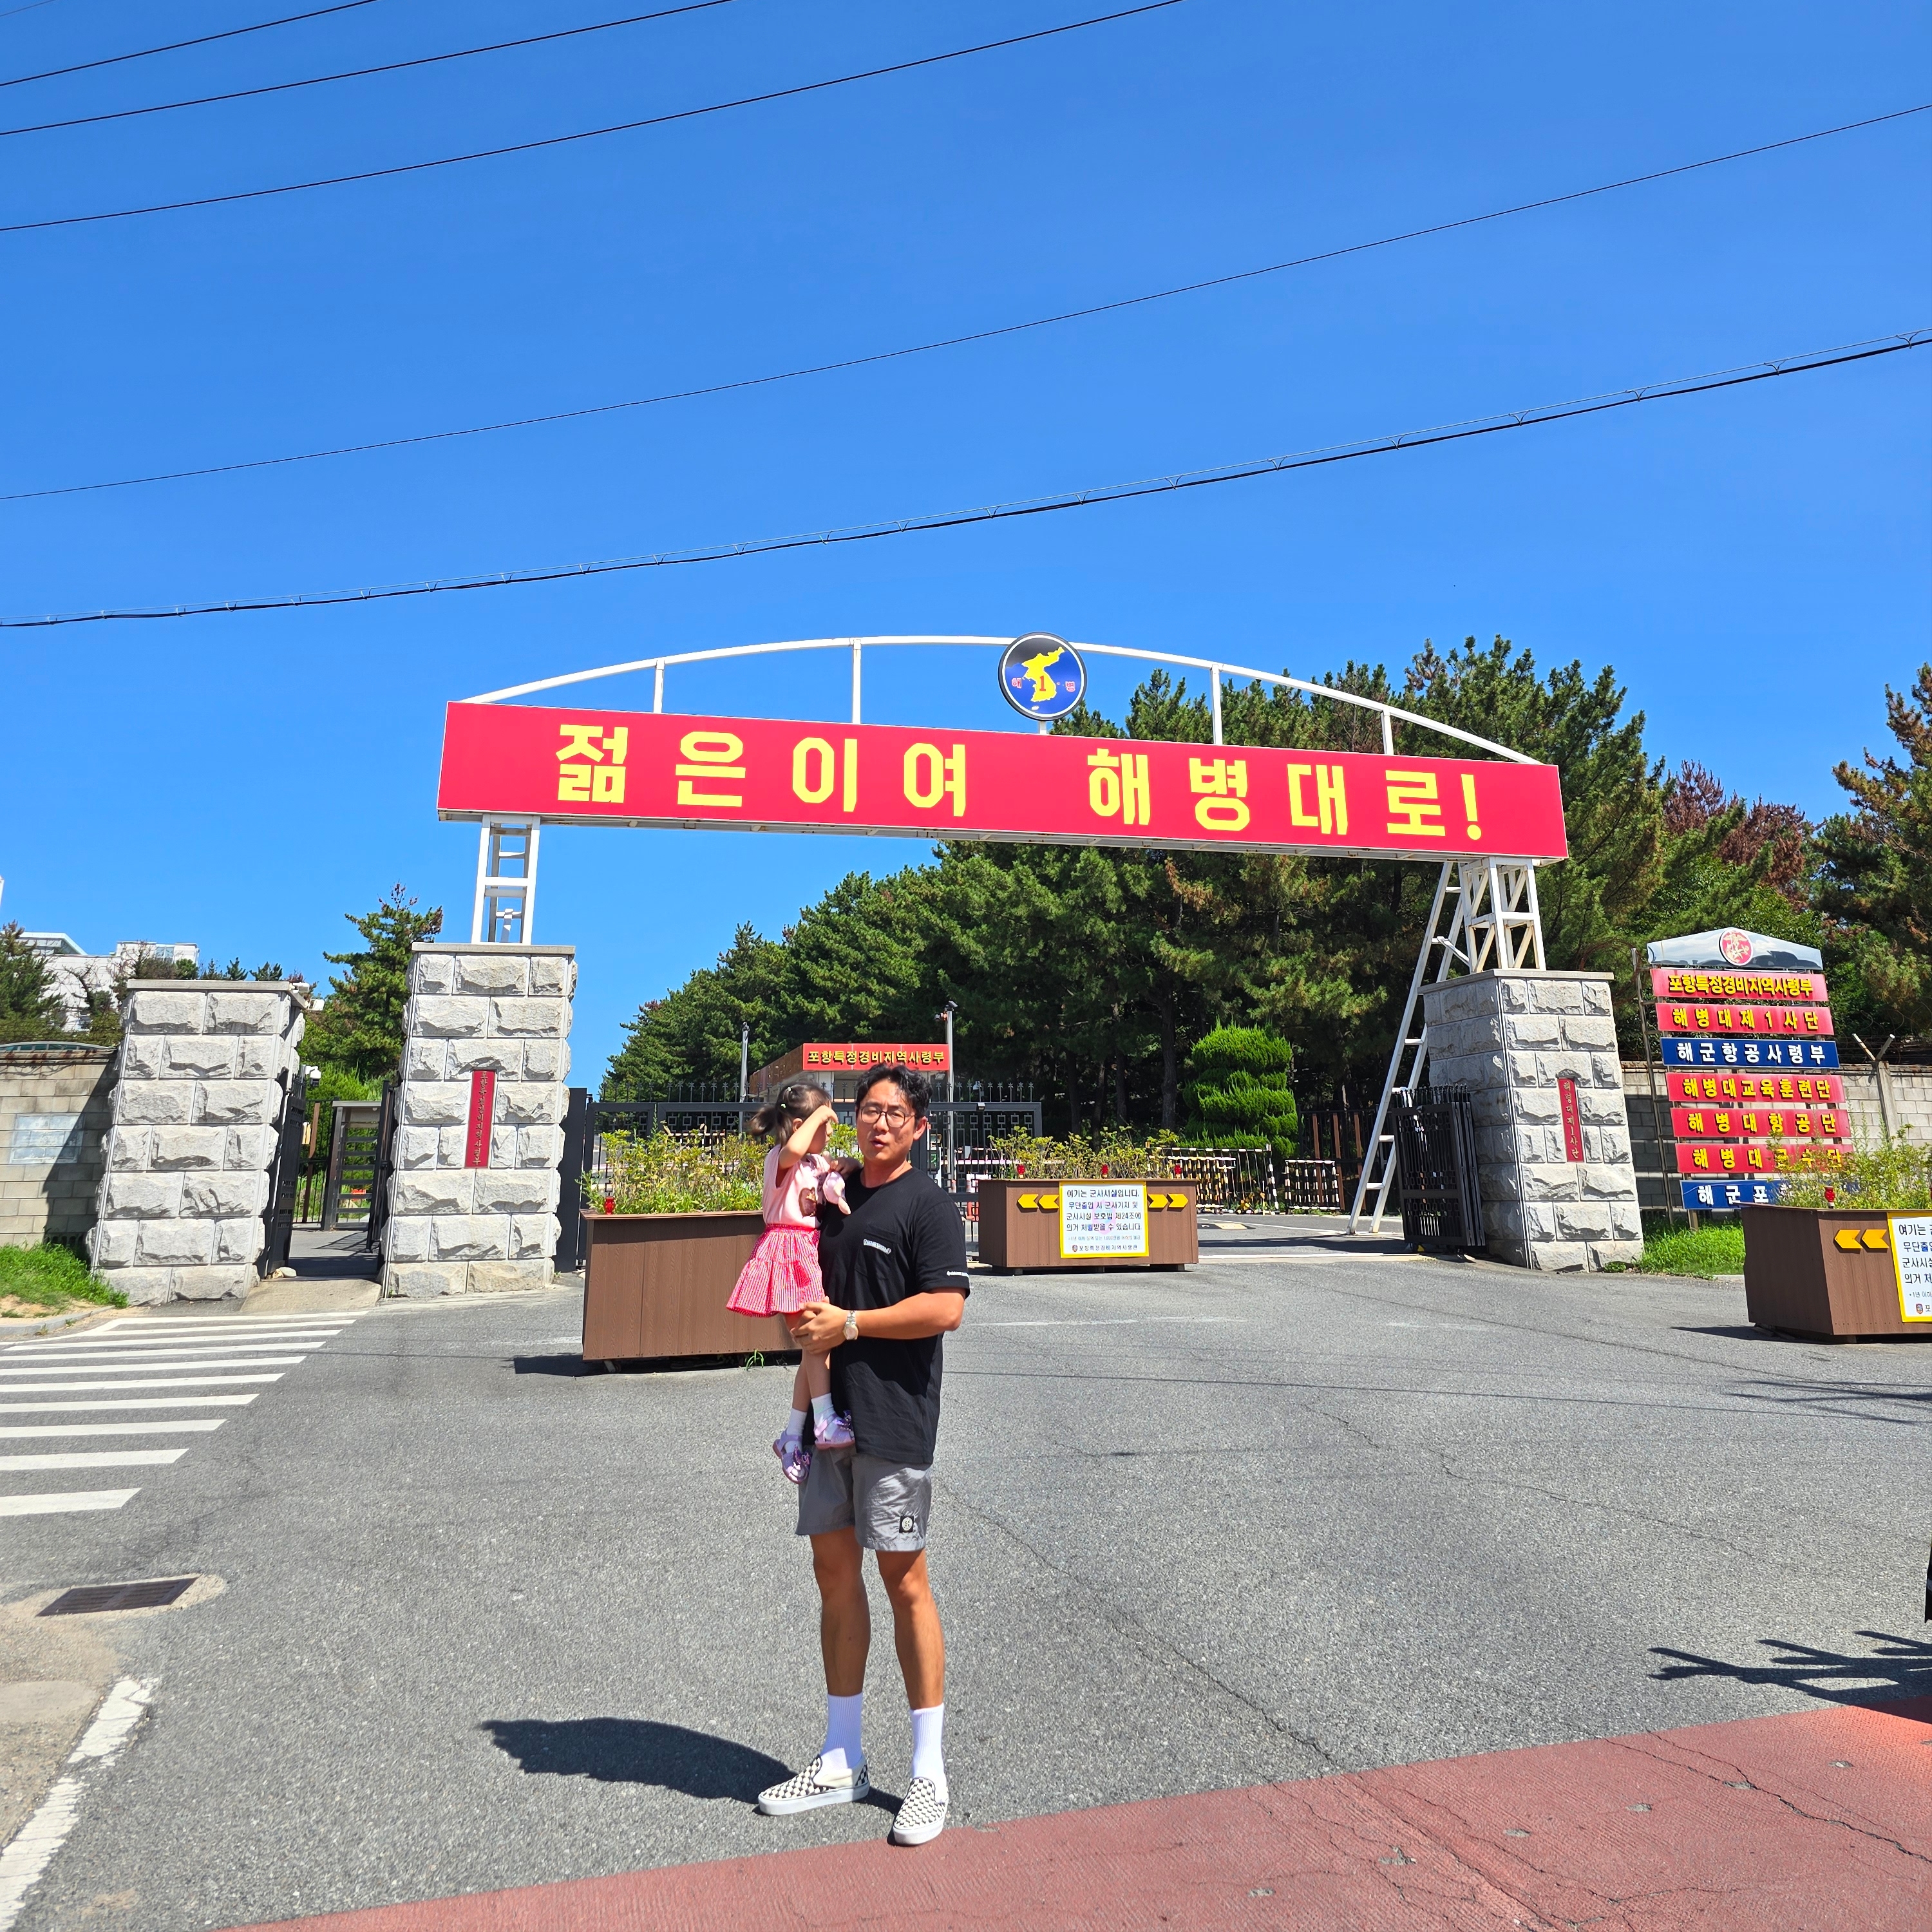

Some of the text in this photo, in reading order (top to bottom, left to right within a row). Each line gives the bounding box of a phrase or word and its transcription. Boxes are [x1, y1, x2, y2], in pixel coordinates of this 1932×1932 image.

[1011, 676, 1075, 692] 해 1 병
[556, 724, 1482, 840] 젊은이여 해병대로!
[1669, 974, 1813, 998] 포항특정경비지역사령부
[1672, 1007, 1819, 1030] 해병대제1사단
[808, 1050, 945, 1065] 포항특정경비지역사령부
[1677, 1042, 1826, 1065] 해군항공사령부
[1683, 1077, 1830, 1099] 해병대교육훈련단
[1688, 1112, 1836, 1135] 해병대항공단
[1066, 1189, 1139, 1198] 여기는 군사시설입니다.
[1094, 1212, 1113, 1220] 보호법
[1899, 1224, 1926, 1236] 여기는
[1904, 1273, 1922, 1284] 의거
